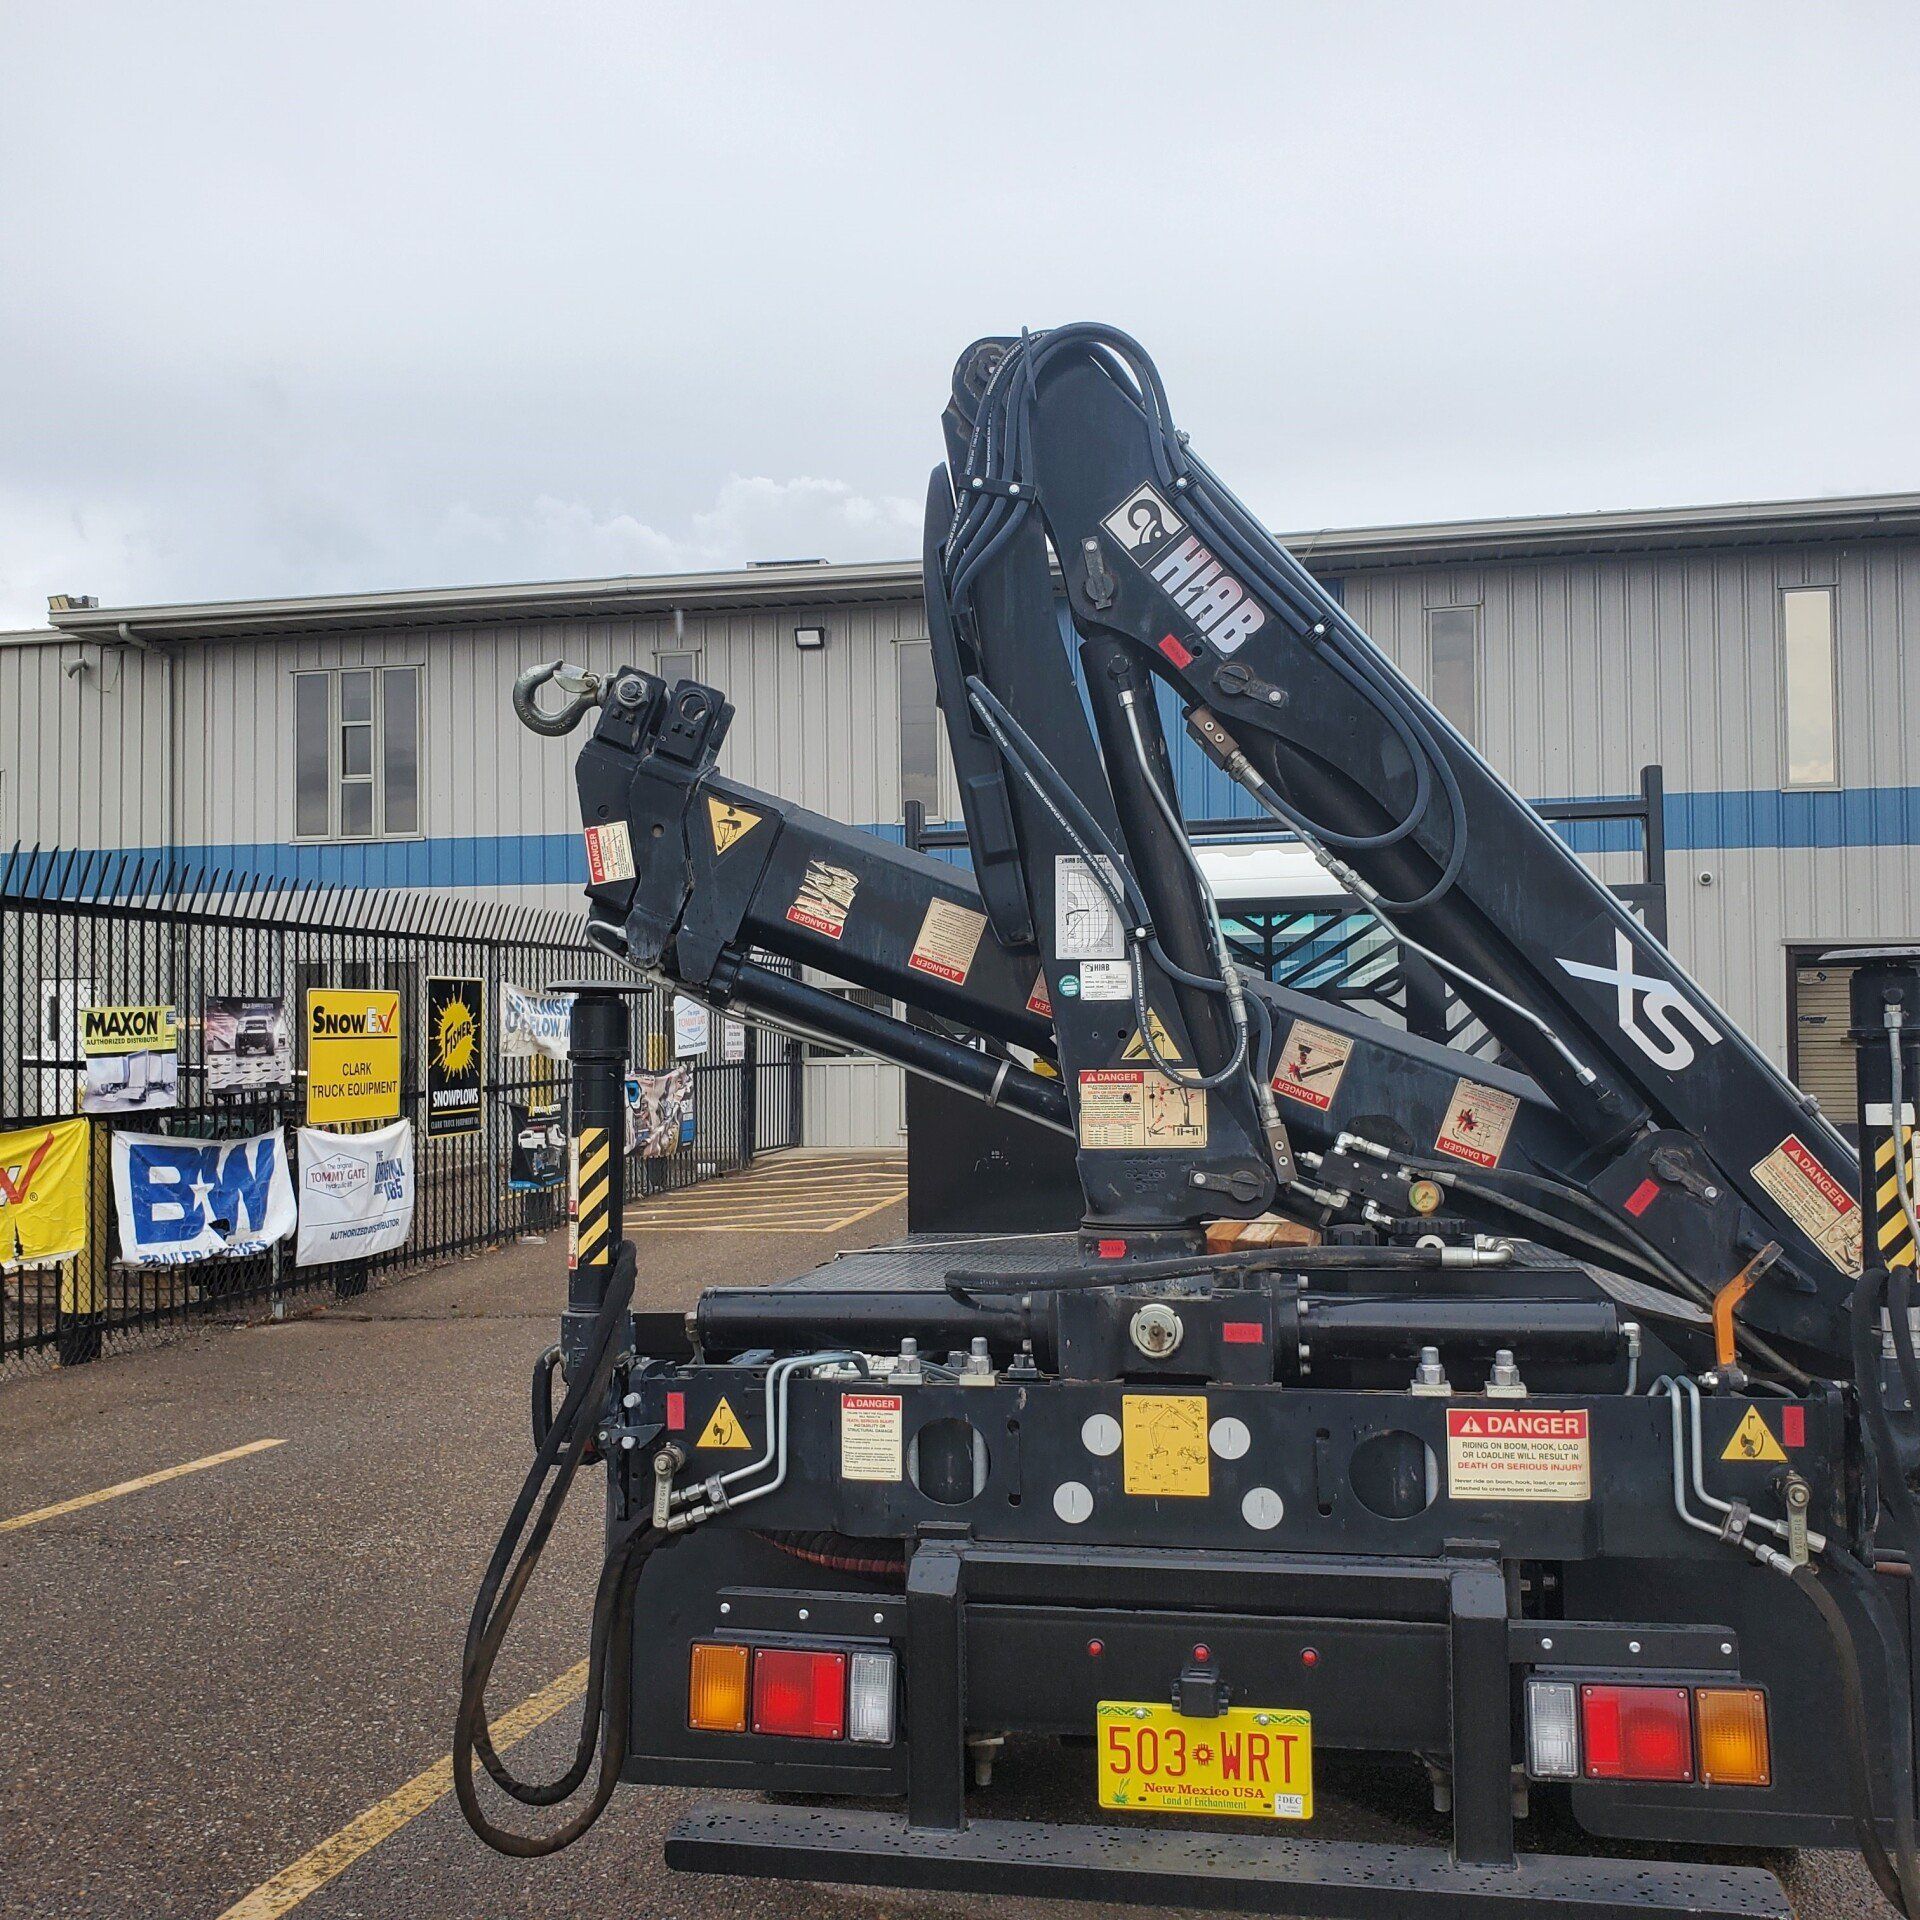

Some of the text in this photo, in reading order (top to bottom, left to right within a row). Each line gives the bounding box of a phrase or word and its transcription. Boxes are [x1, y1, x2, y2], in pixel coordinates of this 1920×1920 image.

[1150, 535, 1265, 653] HIAB
[589, 833, 603, 868] DANGER
[793, 911, 828, 931] DANGER
[916, 957, 950, 976] DANGER
[1554, 927, 1724, 1071] XS
[86, 1011, 158, 1037] MAXON
[86, 1036, 159, 1046] AUTHORIZED DISTRIBUTOR
[444, 1020, 472, 1059] FISHER
[342, 1062, 372, 1077] CLARK
[1097, 1073, 1138, 1082] DANGER
[312, 1080, 398, 1098] TRUCK EQUIPMENT
[433, 1088, 479, 1107] SNOWPLOWS
[1277, 1082, 1313, 1101] DANGER
[1443, 1141, 1481, 1160] DANGER
[311, 1168, 366, 1183] TOMMY GATE
[1799, 1158, 1845, 1208] DANGER
[329, 1225, 370, 1241] AUTHORIZED
[856, 1399, 895, 1409] DANGER
[1487, 1416, 1580, 1435] DANGER
[1462, 1441, 1579, 1451] RIDING ON BOOM, HOOK, LOAD
[1462, 1451, 1474, 1459] OR
[1476, 1451, 1515, 1460] LOADLINE
[1516, 1452, 1536, 1460] WILL
[1538, 1452, 1569, 1460] RESULT
[1457, 1461, 1488, 1469] DEATH
[1490, 1462, 1505, 1470] OR
[1507, 1462, 1549, 1471] SERIOUS
[1108, 1726, 1299, 1784] 503 WRT
[1144, 1782, 1266, 1799] New Mexico USA
[1162, 1794, 1247, 1810] Land of Enchantment
[1282, 1796, 1302, 1805] DEC
